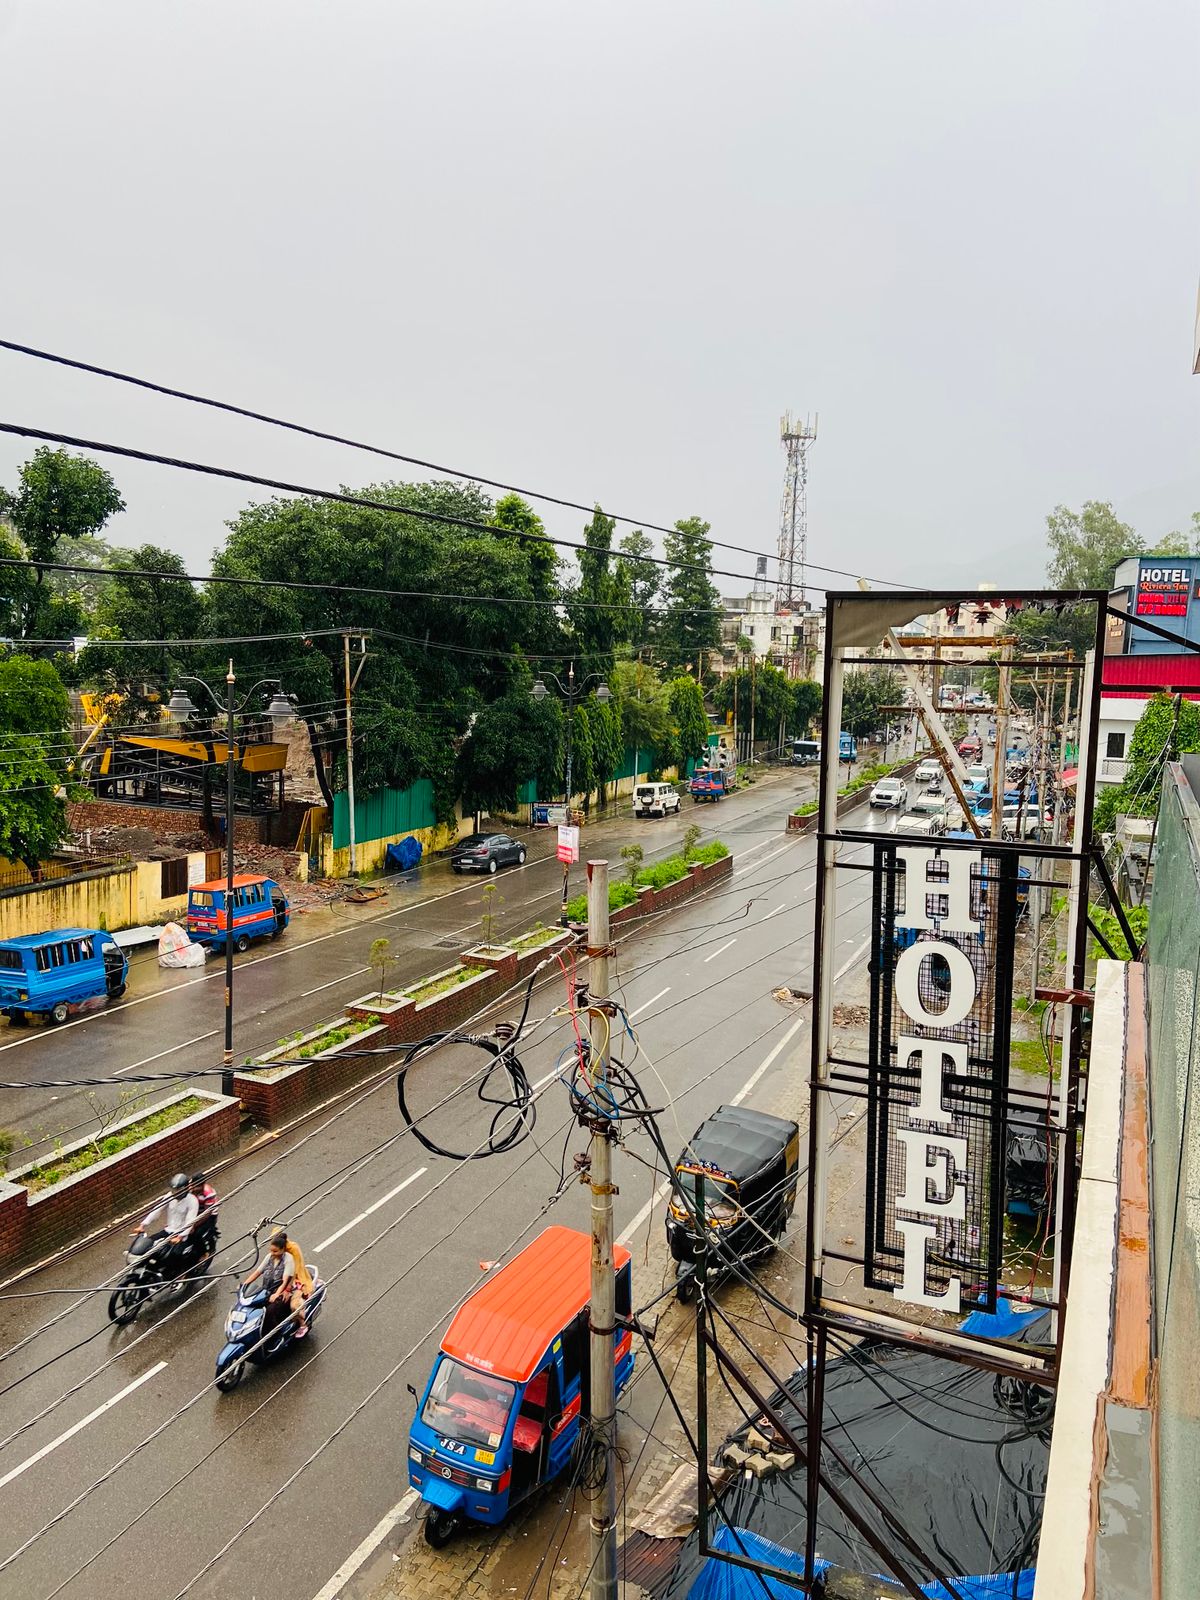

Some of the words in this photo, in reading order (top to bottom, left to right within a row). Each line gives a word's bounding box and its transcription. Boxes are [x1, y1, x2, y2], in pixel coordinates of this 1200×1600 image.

[1140, 568, 1190, 582] HOTEL
[1140, 582, 1171, 592] Riviera
[1173, 582, 1189, 591] Inn
[893, 846, 982, 1313] HOTEL
